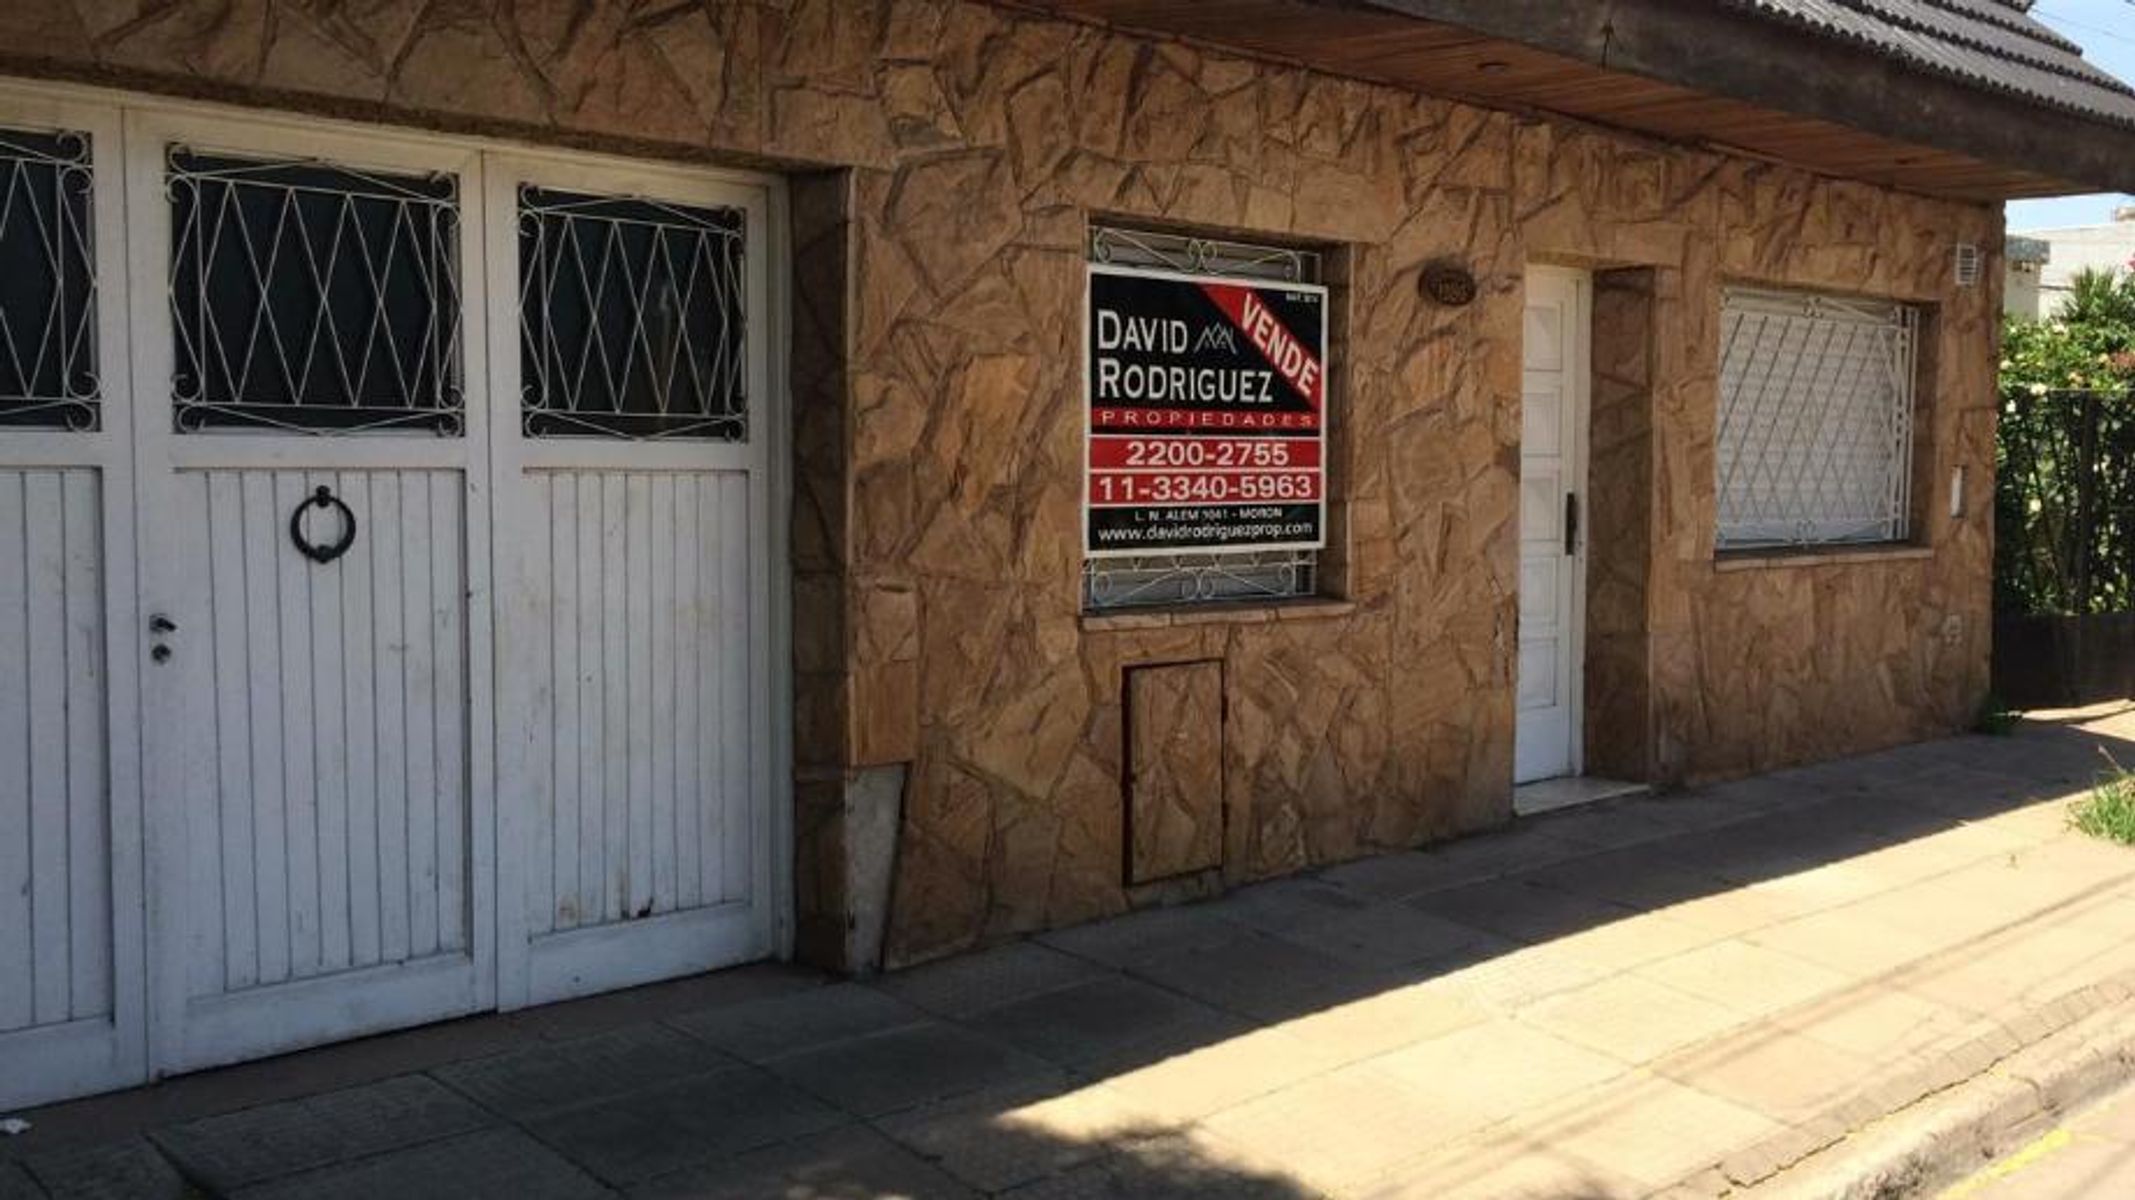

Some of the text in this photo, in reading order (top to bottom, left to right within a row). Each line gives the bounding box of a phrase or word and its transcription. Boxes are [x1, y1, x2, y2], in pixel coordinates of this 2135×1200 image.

[1097, 309, 1188, 355] DAVID
[1240, 292, 1320, 397] VENDE
[1098, 357, 1274, 403] RODRIGUEZ
[1101, 410, 1313, 427] PROPIEDADES
[1125, 441, 1290, 467] 2200-2755
[1099, 475, 1313, 501] 11-3340-5963
[1165, 509, 1199, 521] ALEM
[1098, 521, 1313, 542] www.davidrodriguezprop.com
